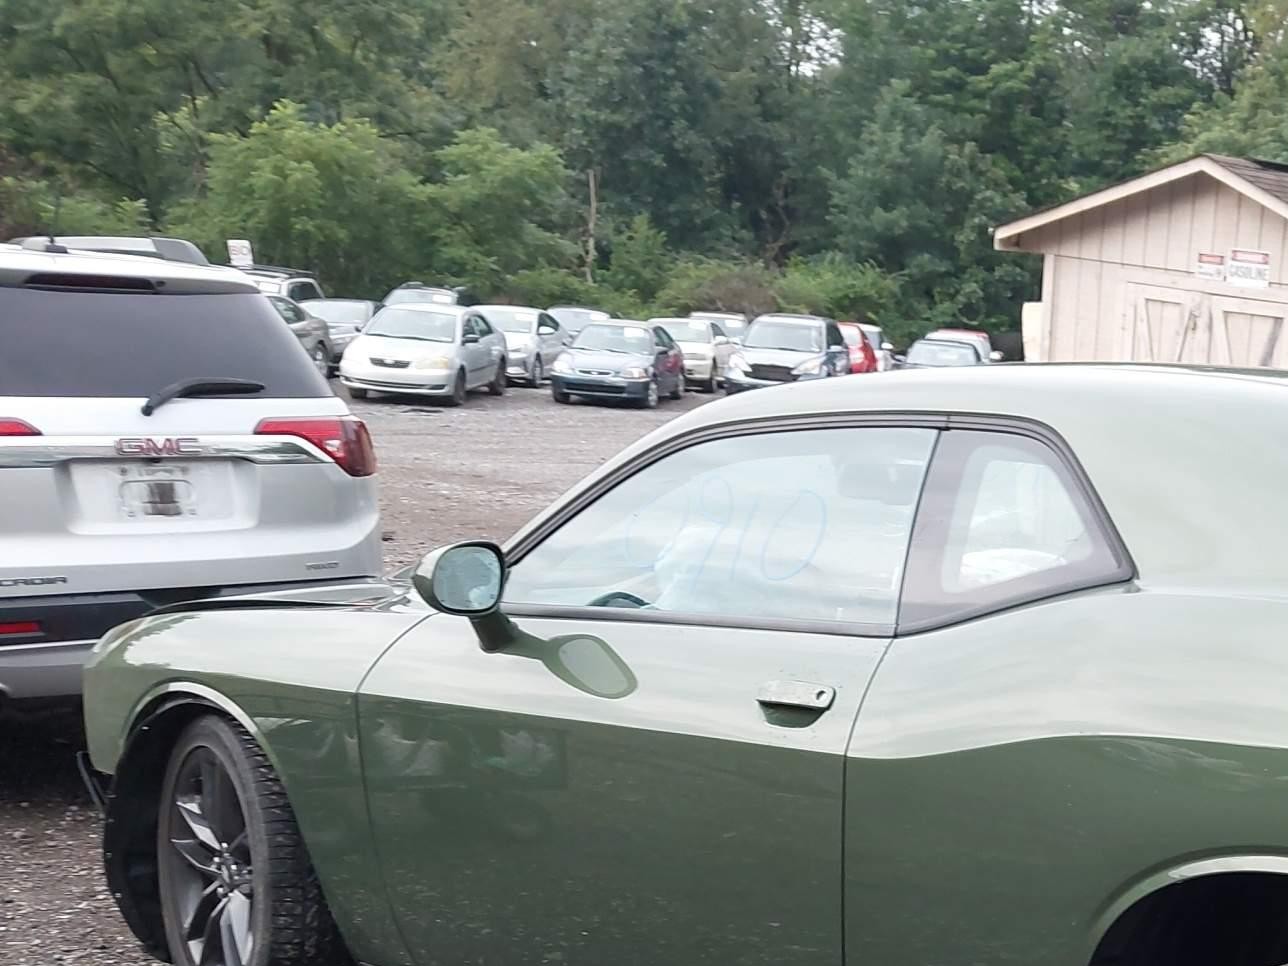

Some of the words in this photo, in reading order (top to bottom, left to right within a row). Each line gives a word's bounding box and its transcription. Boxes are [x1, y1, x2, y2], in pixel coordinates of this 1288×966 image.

[1228, 263, 1269, 281] GASOLINE
[114, 438, 201, 456] GMC
[0, 576, 68, 587] CADIA
